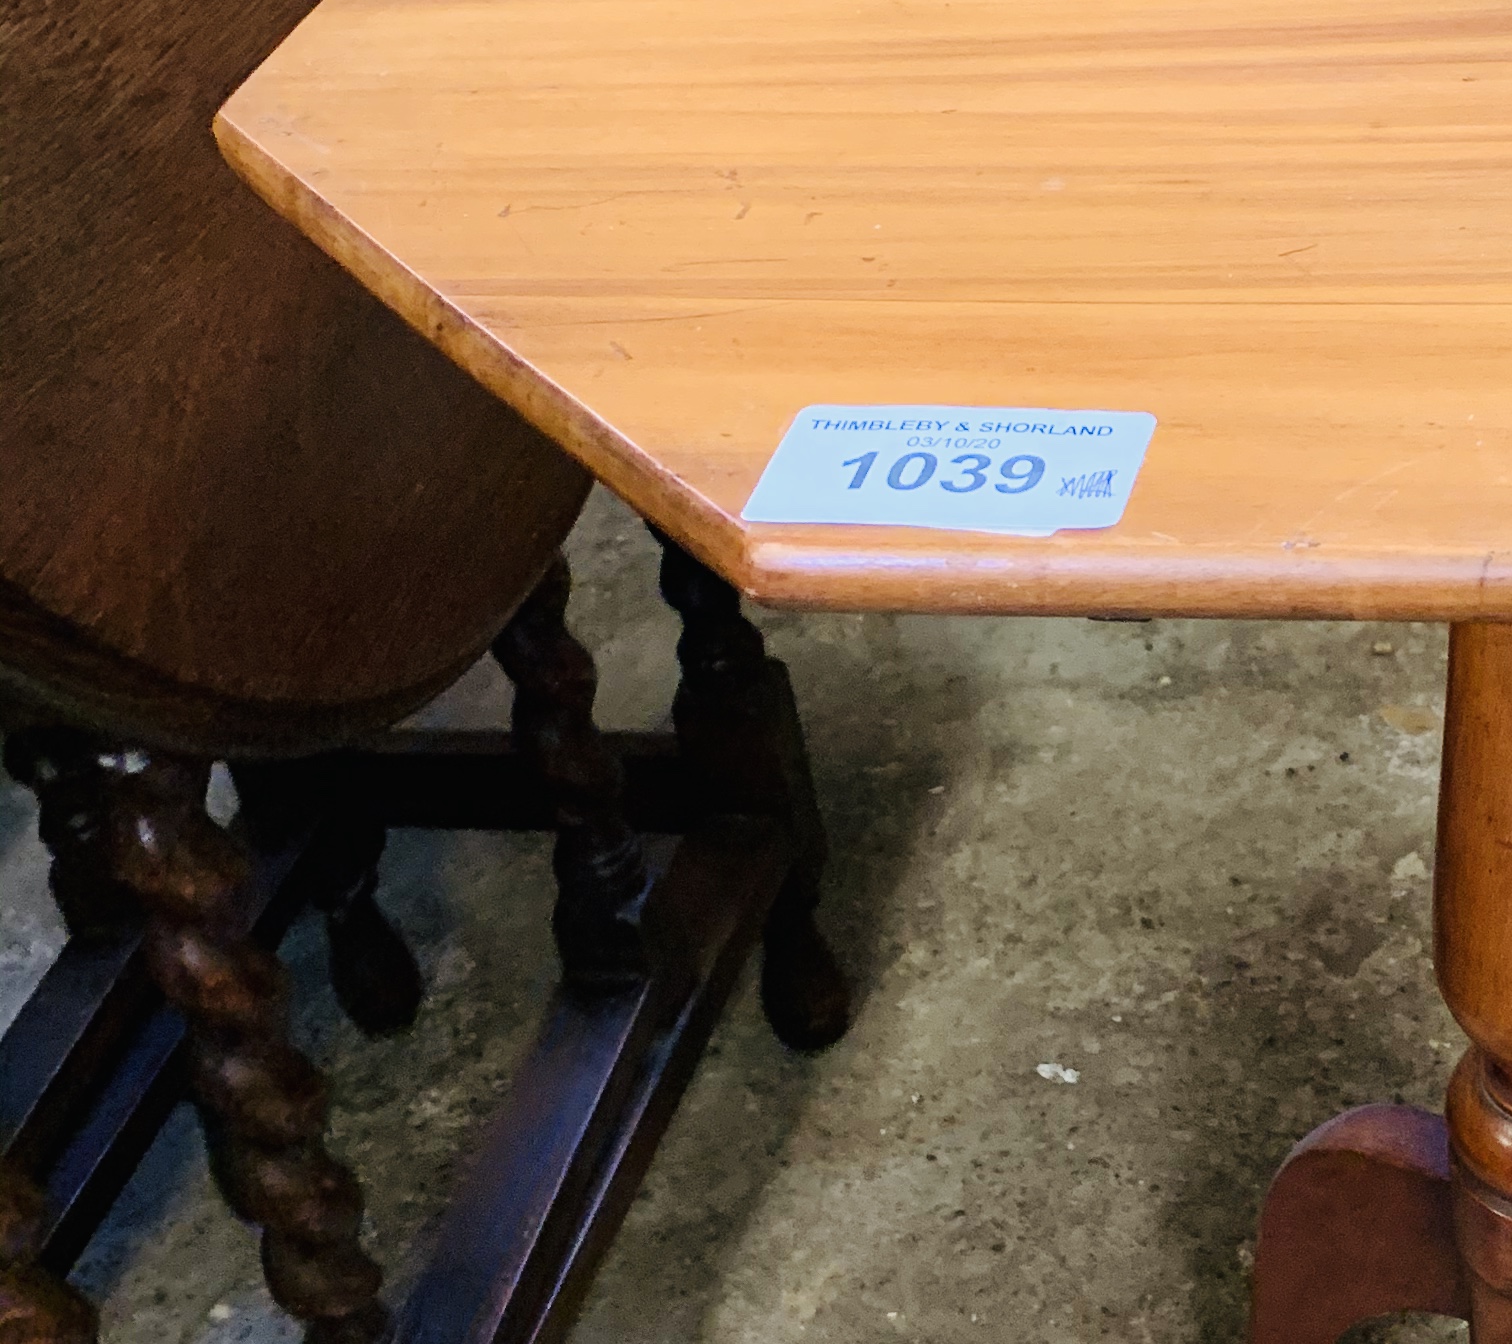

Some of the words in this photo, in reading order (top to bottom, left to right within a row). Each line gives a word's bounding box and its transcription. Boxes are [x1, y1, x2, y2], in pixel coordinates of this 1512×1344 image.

[811, 418, 950, 432] THIMBLEBY
[954, 421, 970, 432] &
[978, 421, 1113, 437] SHORLAND
[906, 435, 1002, 450] 03/10/20
[841, 450, 1046, 495] 1039
